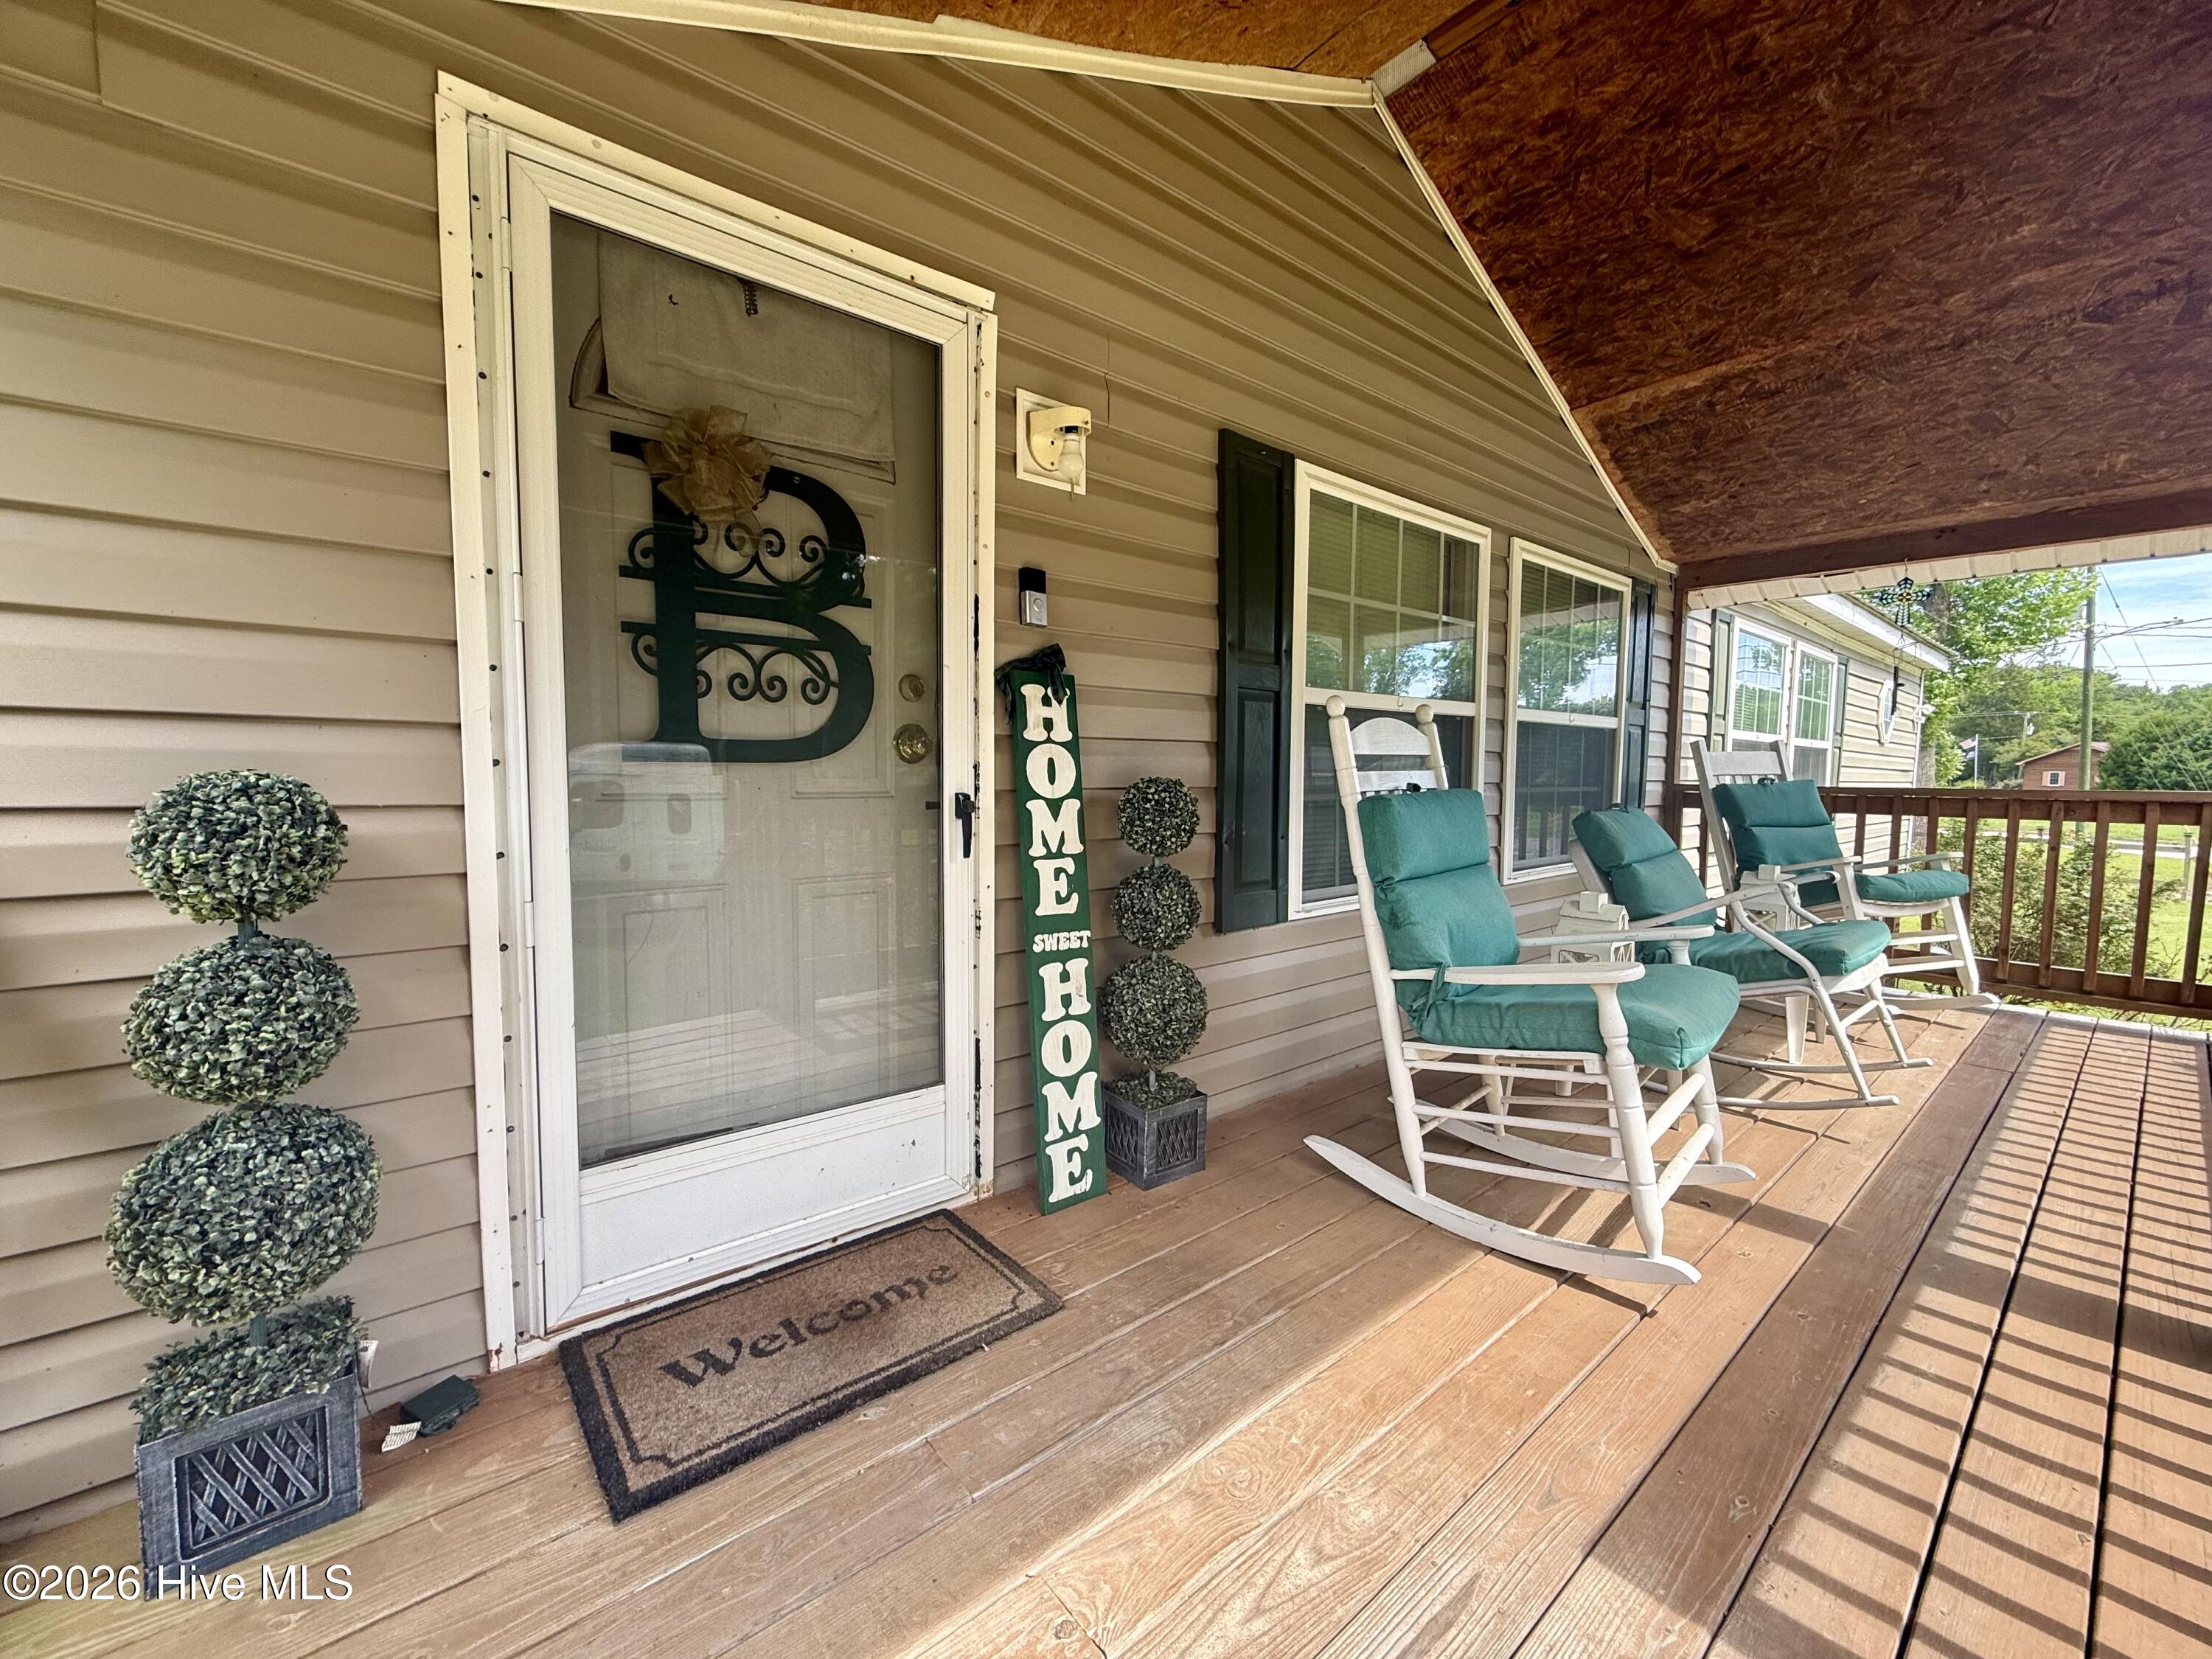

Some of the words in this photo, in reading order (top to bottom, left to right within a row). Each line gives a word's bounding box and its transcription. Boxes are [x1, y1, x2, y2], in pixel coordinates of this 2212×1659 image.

[611, 431, 874, 763] B
[1020, 684, 1084, 917] HOME
[1032, 930, 1091, 953] SWEET
[1038, 957, 1102, 1203] HOME
[658, 1265, 958, 1389] Welcome
